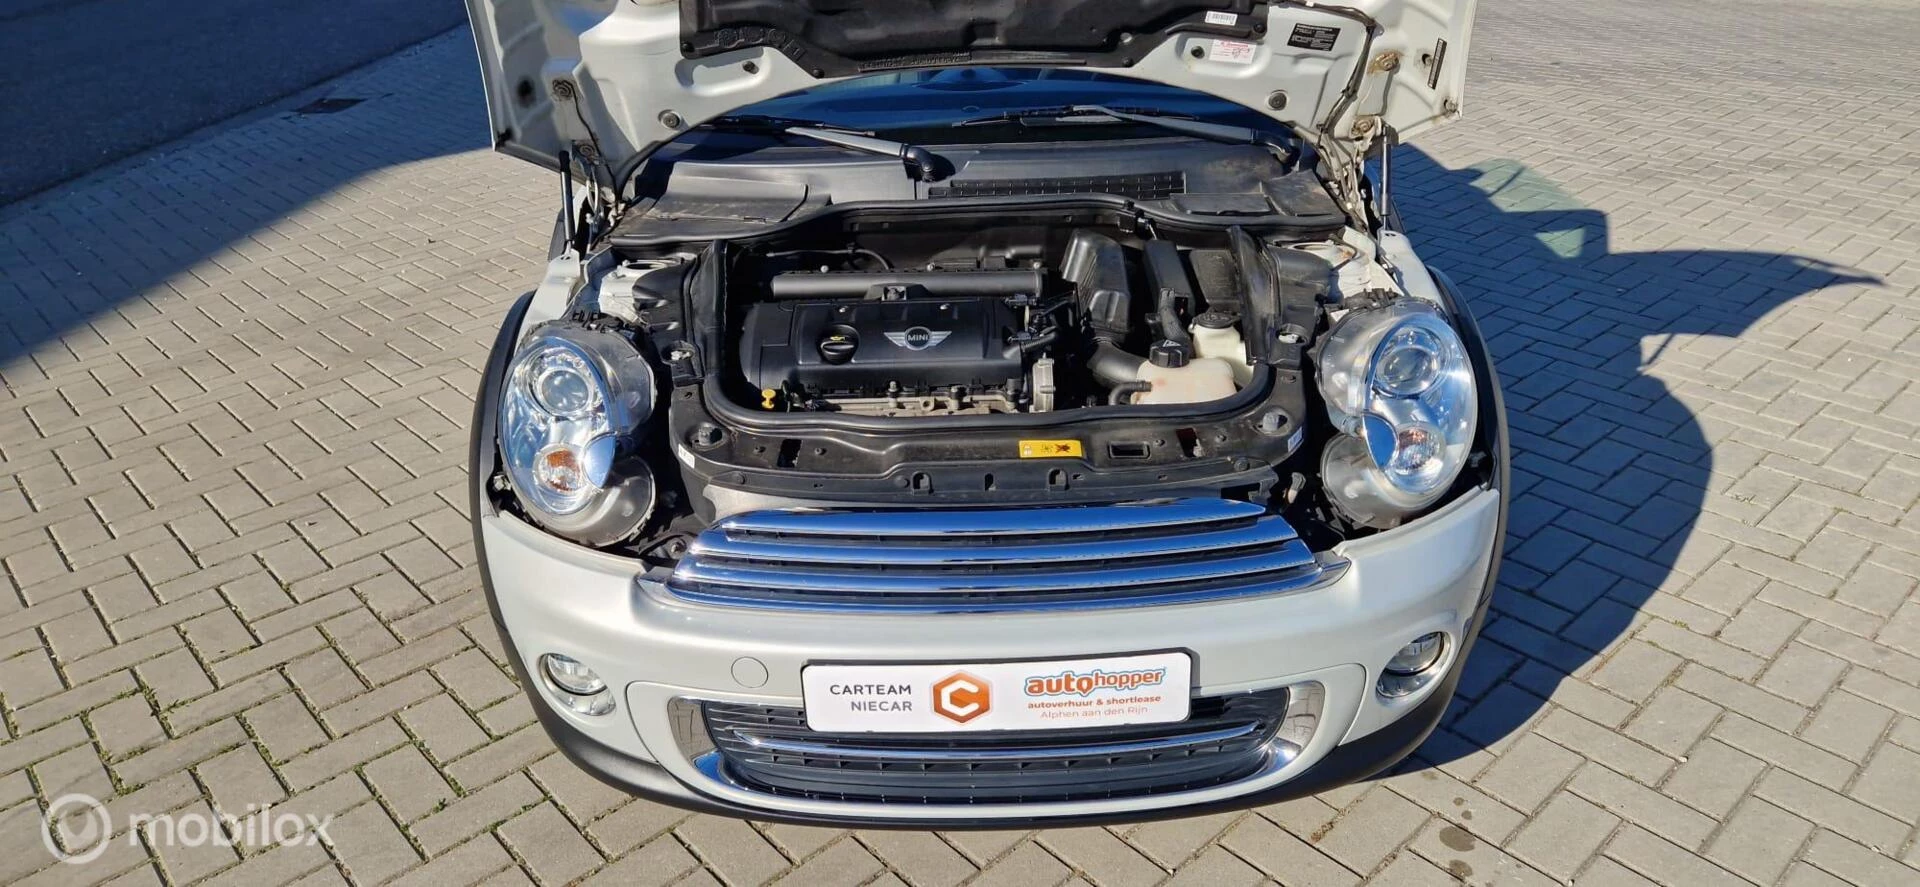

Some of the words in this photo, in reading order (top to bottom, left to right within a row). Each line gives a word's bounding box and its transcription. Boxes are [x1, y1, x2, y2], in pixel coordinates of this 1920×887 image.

[829, 684, 912, 695] CARTEAM
[1027, 671, 1163, 695] autohopper
[851, 701, 913, 712] NIECAR
[1027, 699, 1094, 709] autoverhuur
[1096, 698, 1104, 706] &
[1106, 695, 1162, 705] shortlease
[1040, 709, 1079, 719] Alphen
[1081, 709, 1101, 717] aan
[1104, 706, 1125, 716] den
[1127, 705, 1148, 715] Rijn
